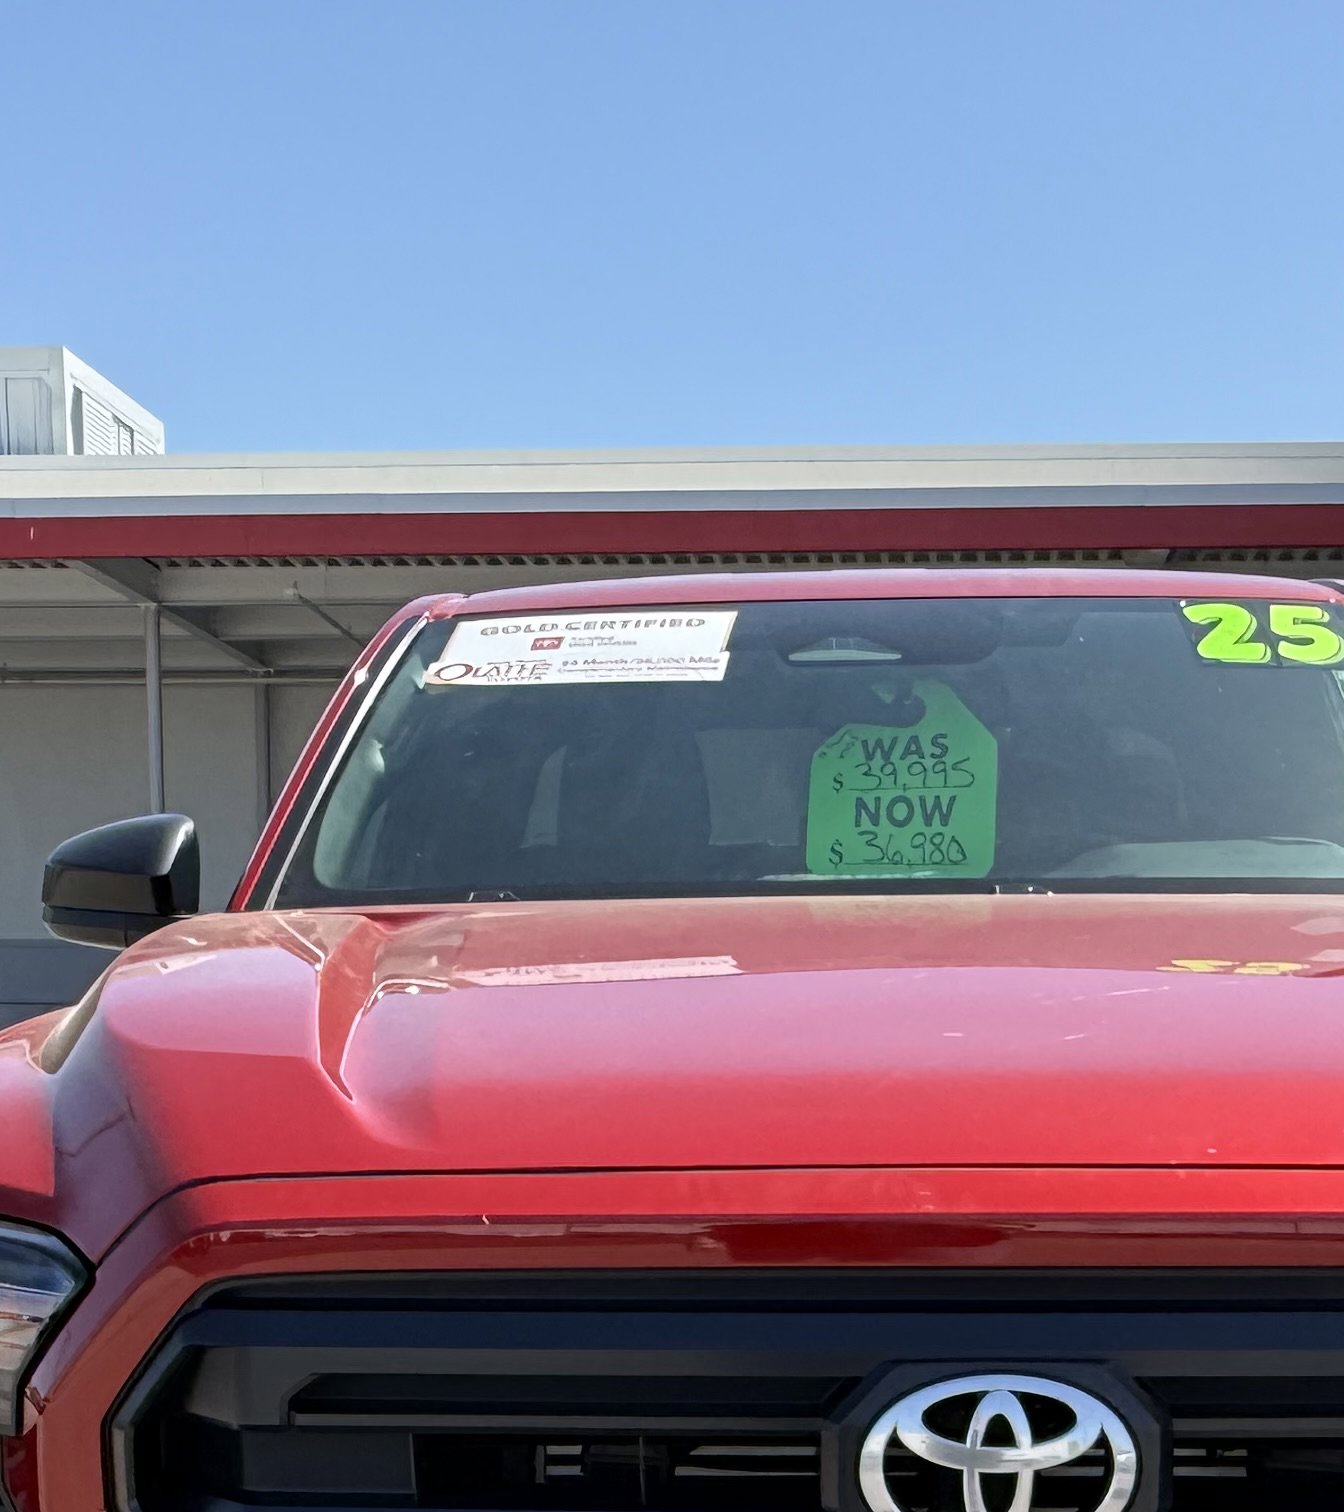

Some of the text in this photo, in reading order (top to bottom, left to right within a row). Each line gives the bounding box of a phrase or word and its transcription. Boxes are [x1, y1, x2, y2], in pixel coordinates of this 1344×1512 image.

[480, 622, 559, 637] GOLD
[861, 733, 949, 762] WAS
[854, 795, 958, 828] NOW
